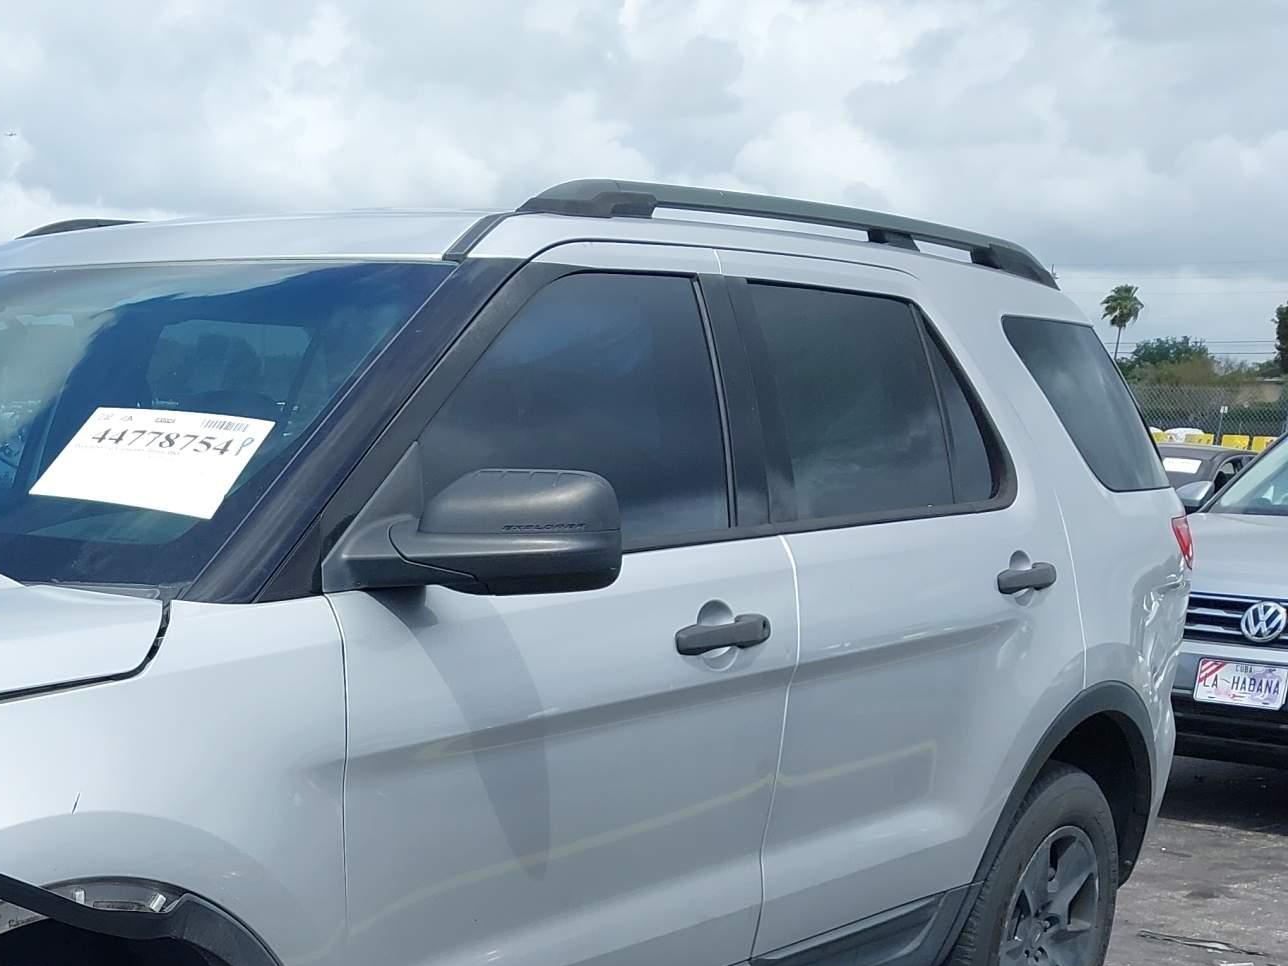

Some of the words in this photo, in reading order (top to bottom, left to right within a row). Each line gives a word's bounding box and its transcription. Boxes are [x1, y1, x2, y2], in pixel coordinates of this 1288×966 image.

[92, 428, 234, 456] 44778754
[1235, 665, 1253, 674] CUBA
[1203, 673, 1219, 689] LA
[1231, 675, 1279, 695] HABANA
